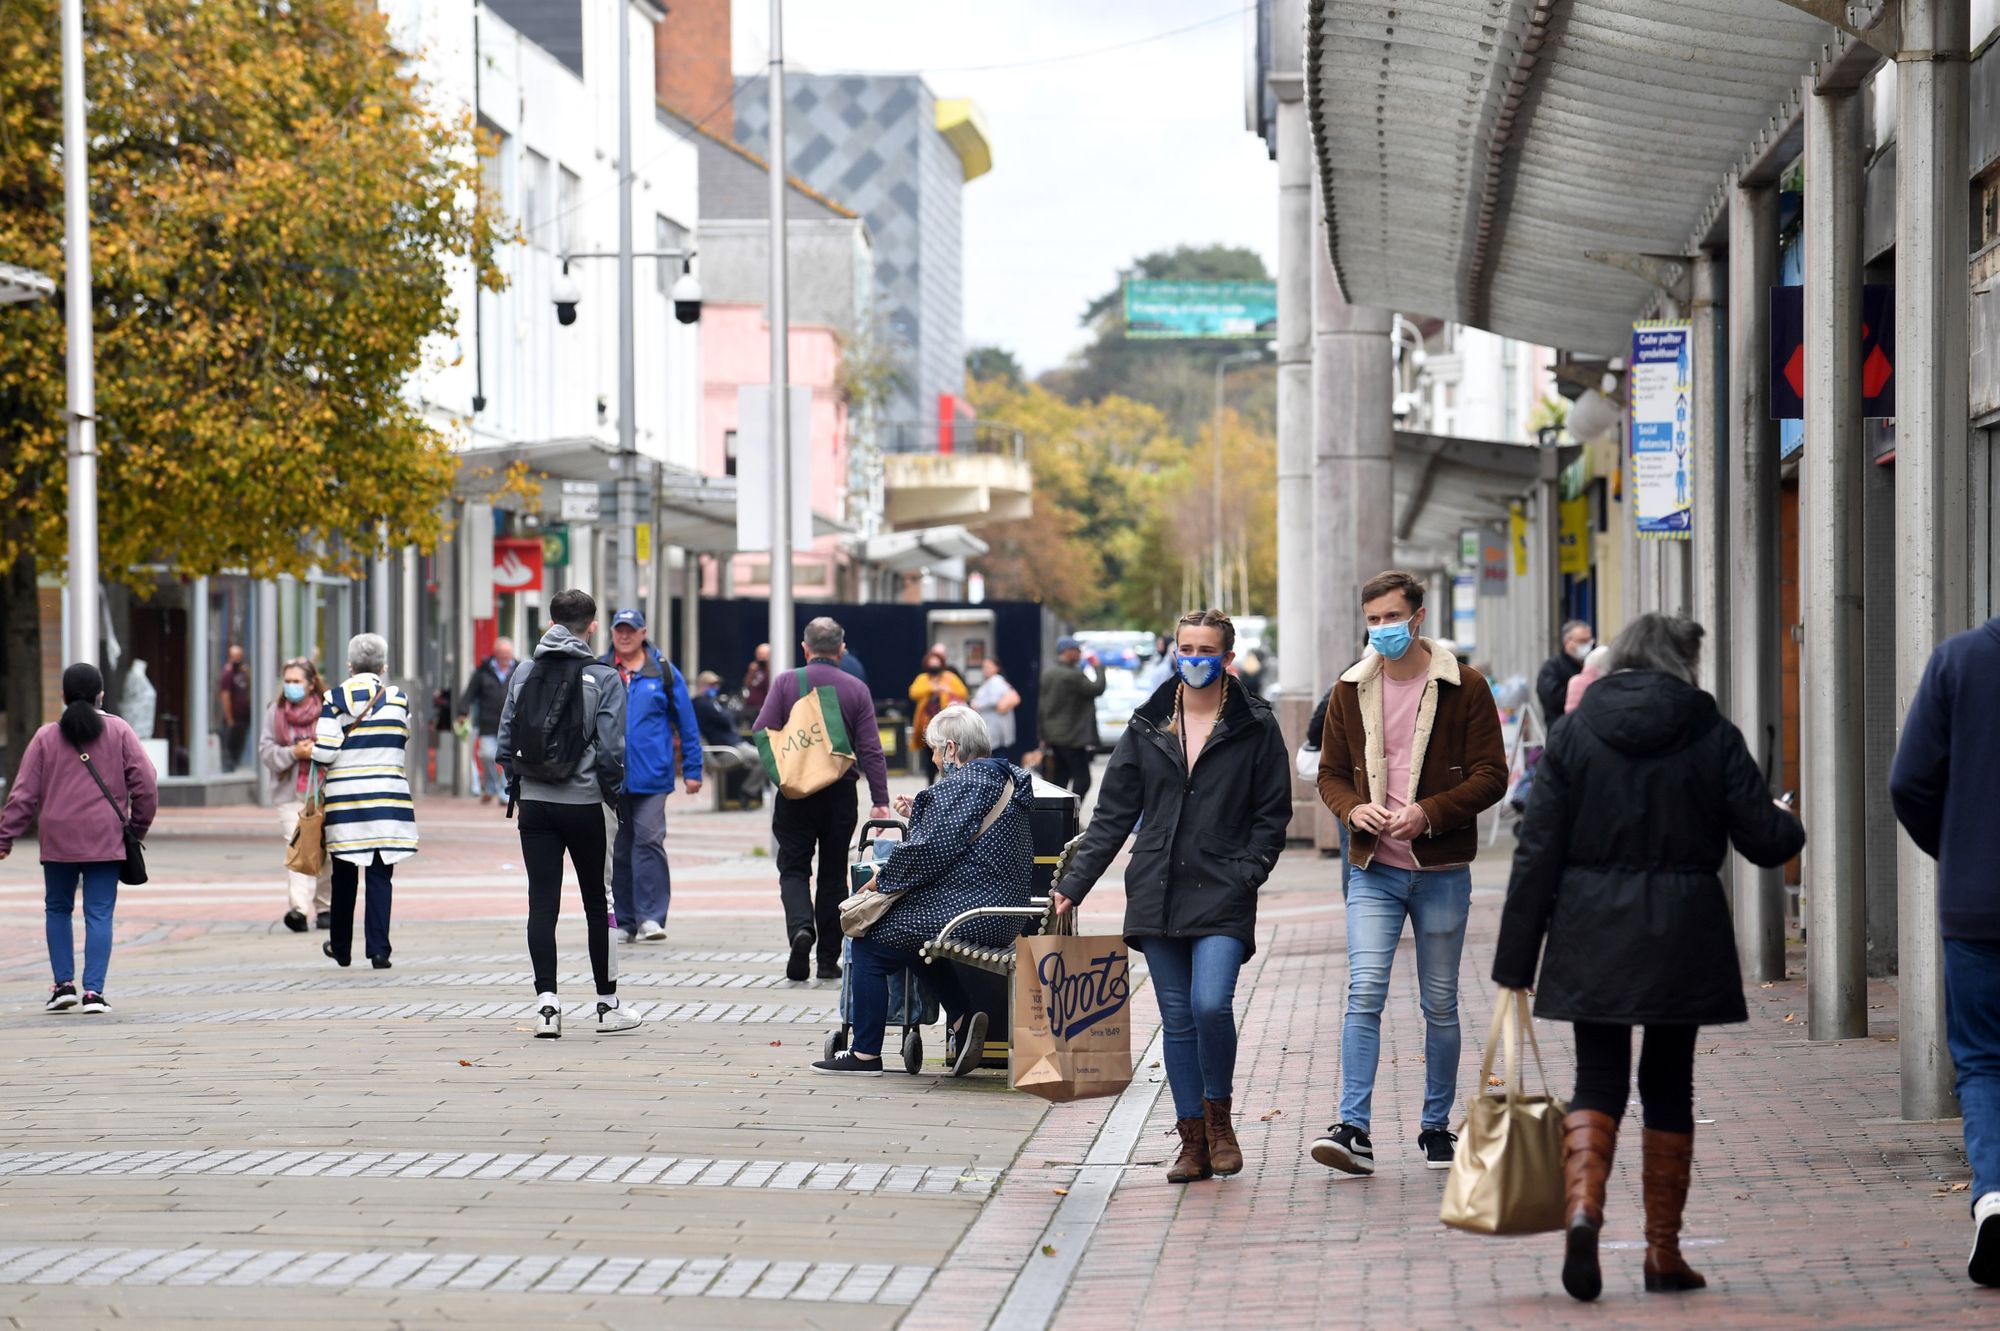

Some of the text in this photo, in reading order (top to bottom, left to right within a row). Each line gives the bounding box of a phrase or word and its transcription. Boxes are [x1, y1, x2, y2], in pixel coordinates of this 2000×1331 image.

[1638, 423, 1658, 435] Social
[1638, 437, 1671, 451] distancing
[781, 722, 824, 759] M&S
[1038, 951, 1130, 1039] Boots
[1090, 1027, 1121, 1037] Since 1849
